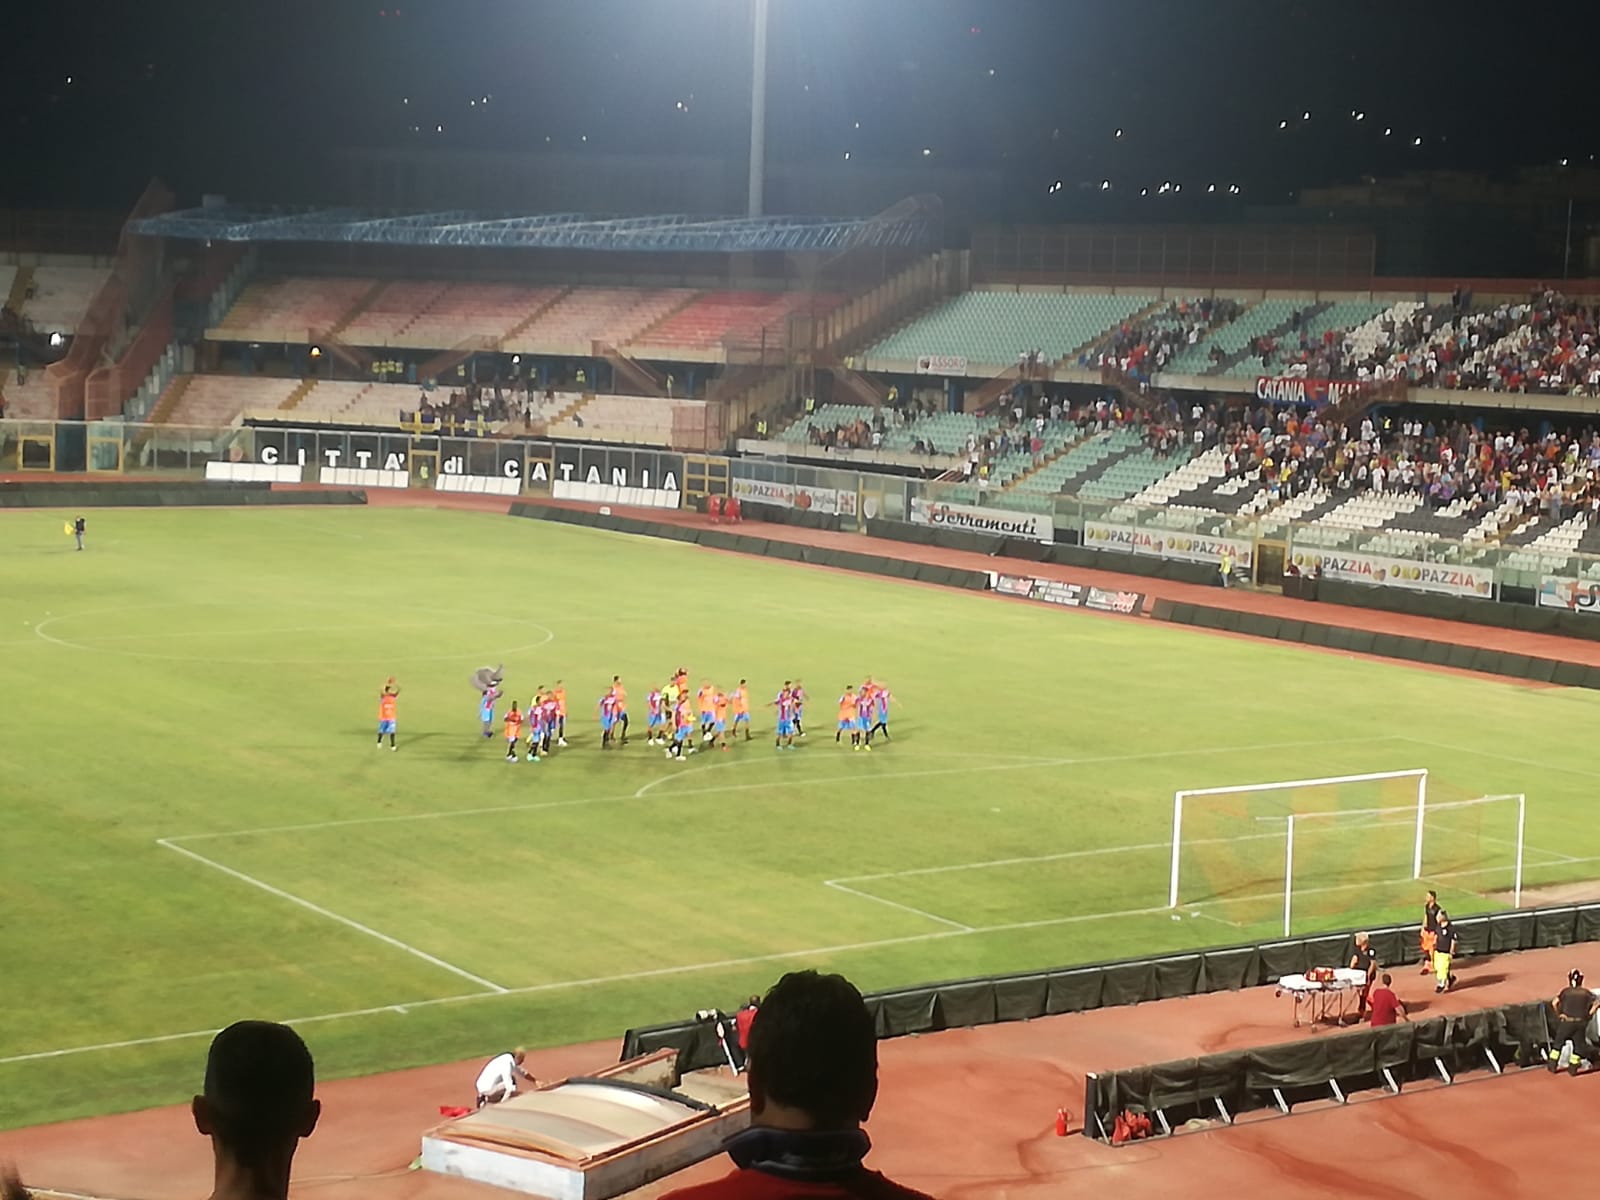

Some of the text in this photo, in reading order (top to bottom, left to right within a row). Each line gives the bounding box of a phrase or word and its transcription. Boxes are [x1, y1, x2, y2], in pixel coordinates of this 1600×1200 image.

[1257, 378, 1305, 402] CATANIA
[443, 455, 463, 475] di
[503, 459, 677, 490] CATANIA
[932, 504, 1037, 536] Serramenti
